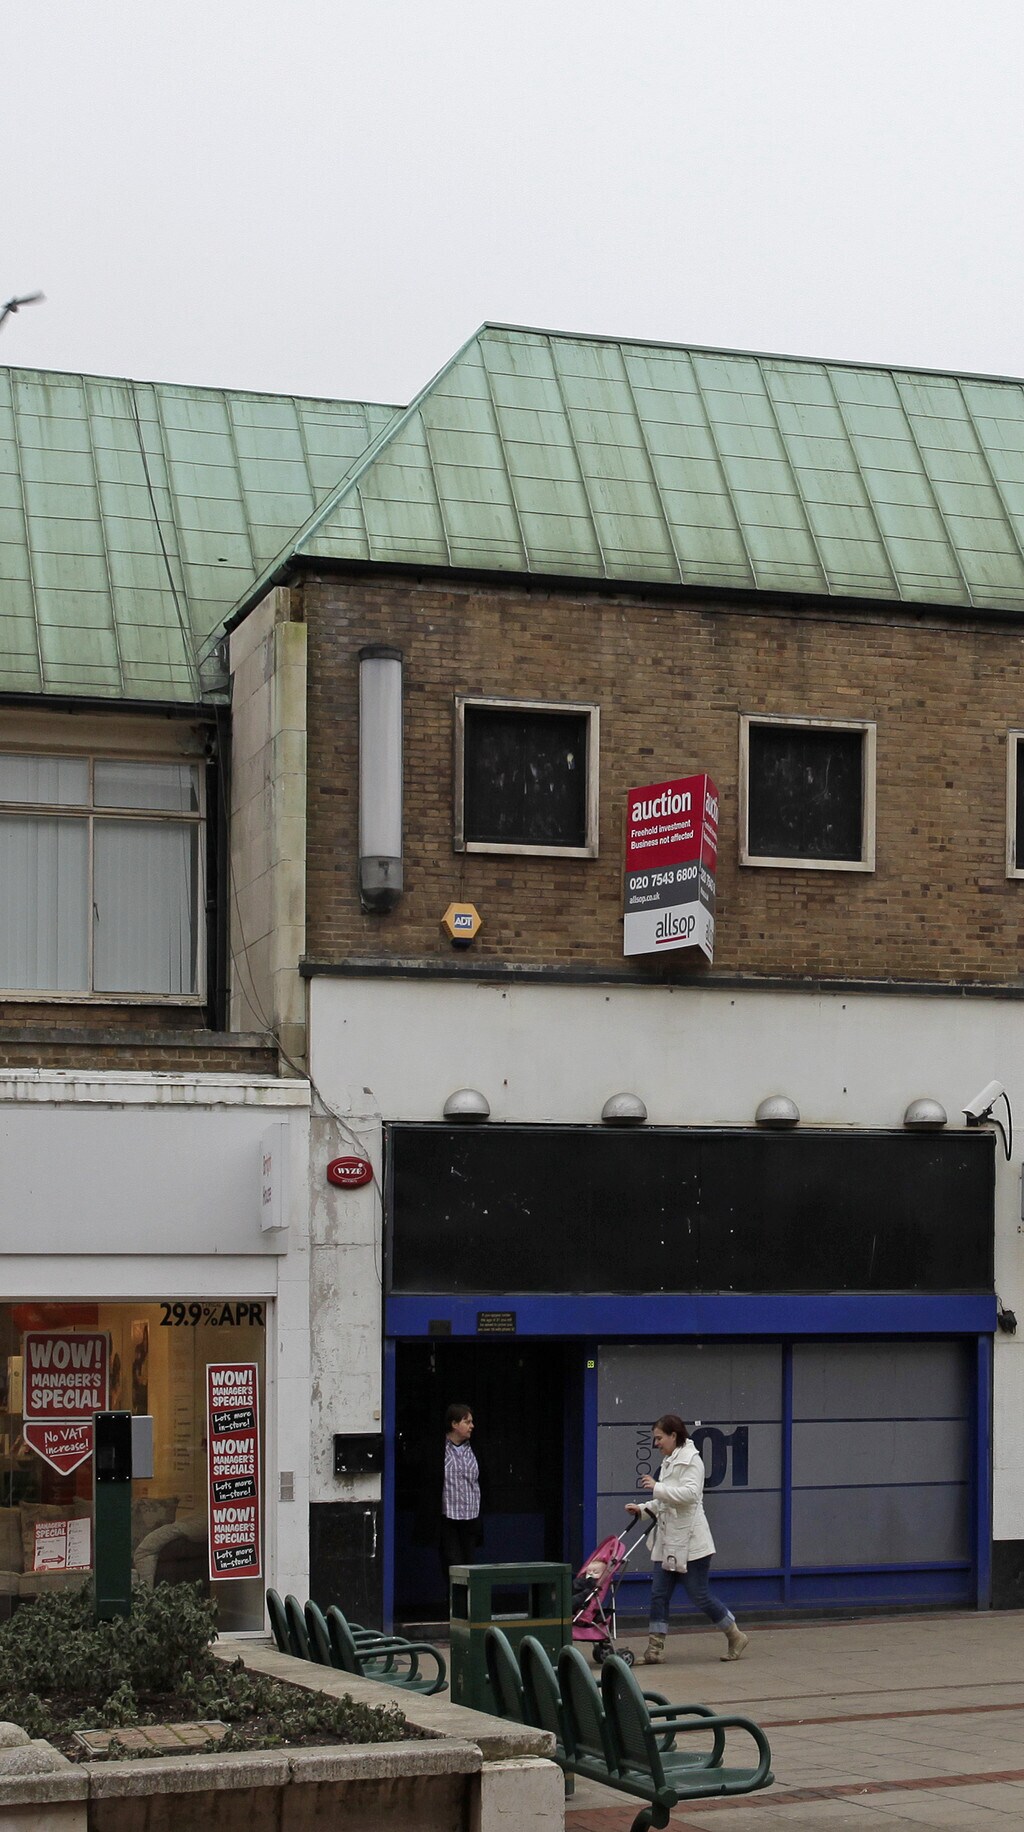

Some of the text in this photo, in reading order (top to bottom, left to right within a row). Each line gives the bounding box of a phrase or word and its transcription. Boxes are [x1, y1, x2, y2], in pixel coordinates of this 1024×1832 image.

[632, 789, 691, 822] auction
[631, 825, 658, 838] Freehold
[659, 819, 691, 832] investment
[631, 838, 658, 850] Business
[659, 836, 670, 844] not
[671, 830, 694, 842] affected
[630, 866, 698, 890] 020 7543 6800
[629, 892, 660, 904] allsop.co.uk
[454, 917, 473, 926] ADT
[655, 912, 696, 939] allsop
[30, 1340, 102, 1369] WOW!
[31, 1373, 102, 1387] MANAGER'S
[211, 1370, 253, 1386] WOW!
[212, 1386, 253, 1396] MANAGER'S
[31, 1389, 102, 1409] SPECIAL
[212, 1395, 254, 1407] SPECIALS
[214, 1411, 252, 1422] Lots more
[218, 1418, 250, 1431] in-store!
[44, 1426, 88, 1444] No VAT
[45, 1438, 89, 1454] increase!
[212, 1438, 255, 1454] WOW!
[213, 1454, 255, 1464] MANAGER'S
[213, 1464, 255, 1475] SPECIALS
[215, 1479, 253, 1491] Lots more
[219, 1487, 251, 1499] in-store!
[213, 1507, 255, 1523] WOW!
[36, 1528, 66, 1538] SPECIAL
[214, 1523, 255, 1533] MANAGER'S
[214, 1532, 255, 1544] SPECIALS
[216, 1547, 254, 1559] Lots more
[220, 1555, 252, 1568] in-store!
